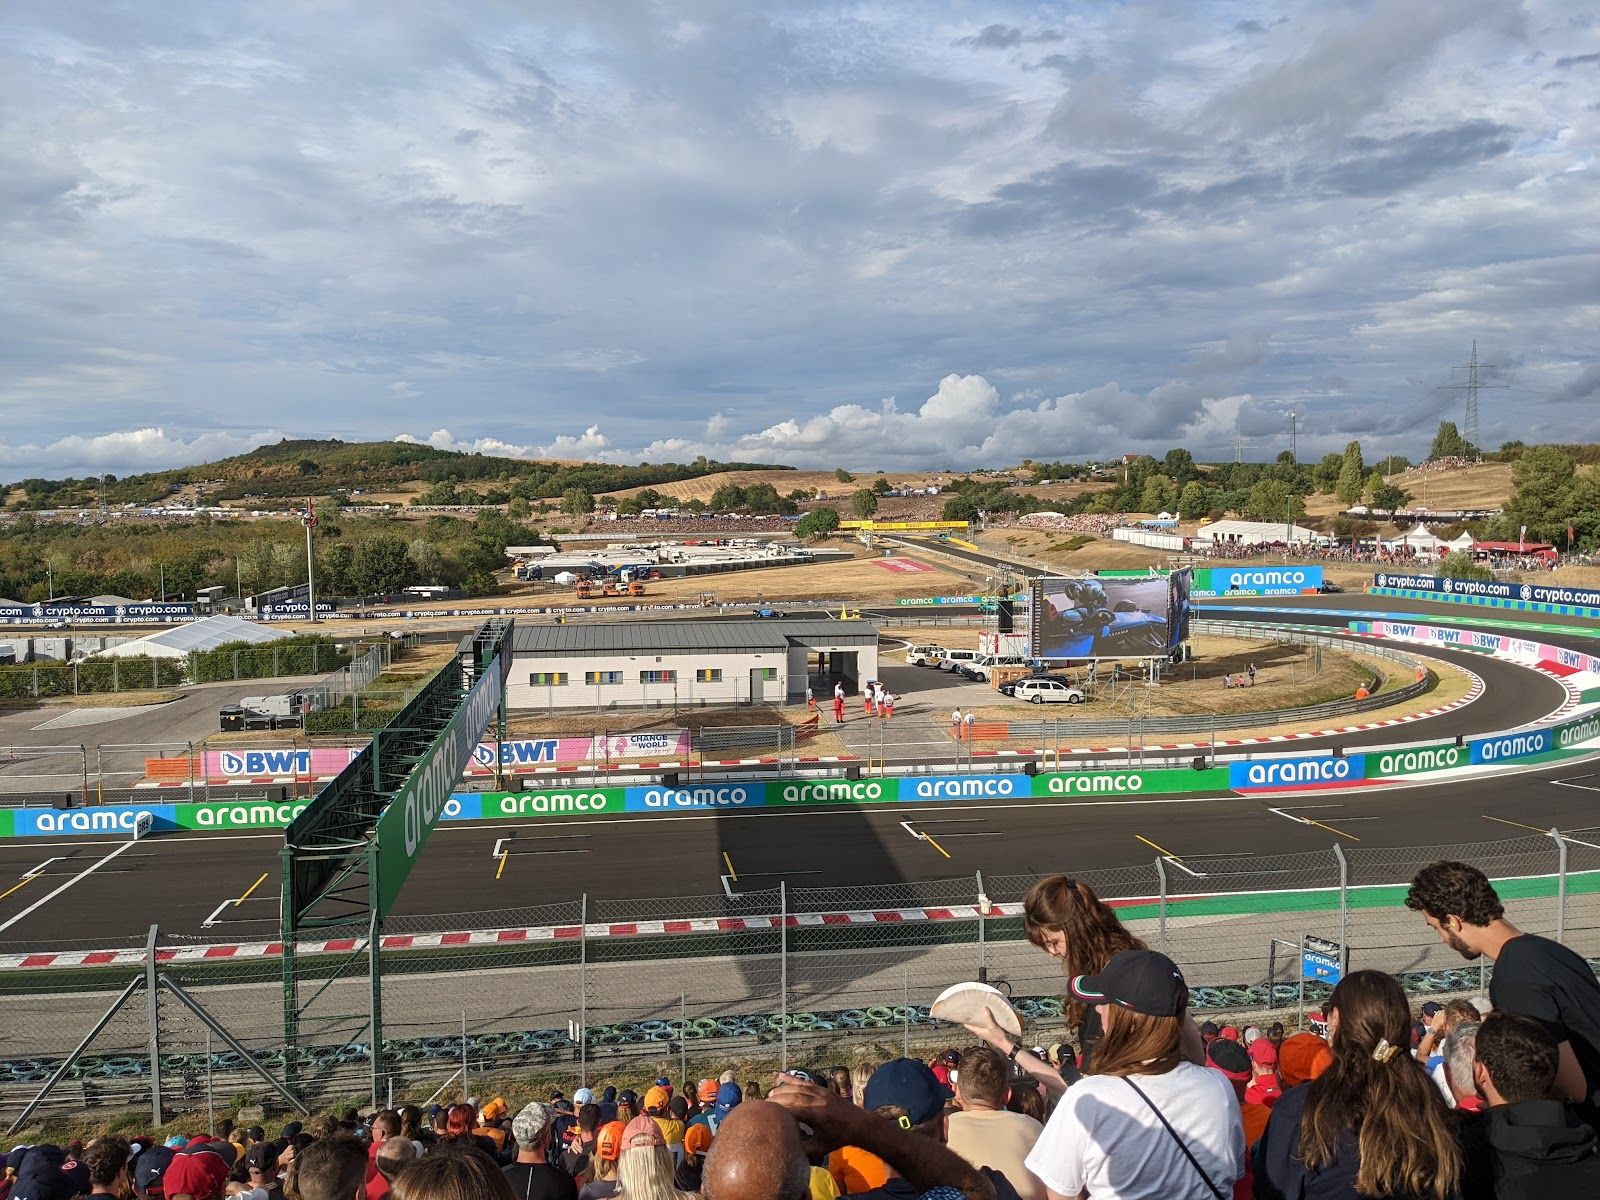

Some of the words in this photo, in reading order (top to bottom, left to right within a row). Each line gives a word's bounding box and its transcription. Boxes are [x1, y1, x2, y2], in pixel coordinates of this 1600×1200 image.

[1230, 571, 1305, 585] aramco
[1388, 575, 1434, 589] crypto.com
[1264, 587, 1298, 595] aramco
[1455, 581, 1510, 597] crypto.com
[901, 597, 934, 605] aramco
[941, 596, 974, 604] aramco
[1534, 588, 1600, 606] crypto.com
[46, 606, 105, 618] crypto.com
[129, 605, 187, 616] crypto.com
[275, 602, 332, 613] crypto.om
[414, 609, 448, 618] crypto.com
[461, 608, 495, 616] crypto.com
[507, 607, 540, 615] crypto.com
[597, 605, 630, 613] crypto.com
[23, 617, 59, 625] crypto.com
[123, 616, 160, 624] crypto.com
[271, 613, 306, 621] crypto.com
[1392, 624, 1416, 637] BWT
[1437, 628, 1461, 643] BWT
[1480, 633, 1501, 650] BWT
[1563, 650, 1580, 668] BWT
[465, 669, 494, 750] aramco
[1560, 715, 1600, 745] aramco
[631, 734, 668, 742] CHANGE
[501, 740, 557, 764] BWT
[1481, 733, 1544, 760] aramco
[246, 751, 309, 773] BWT
[1379, 747, 1459, 774] aramco
[1249, 759, 1349, 784] aramco
[917, 776, 1013, 797] aramco
[1047, 774, 1143, 793] aramco
[404, 729, 457, 858] aramco
[645, 786, 747, 807] aramco
[782, 781, 882, 802] aramco
[500, 792, 607, 813] aramco
[138, 819, 149, 833] DRS
[1304, 953, 1340, 969] aramco
